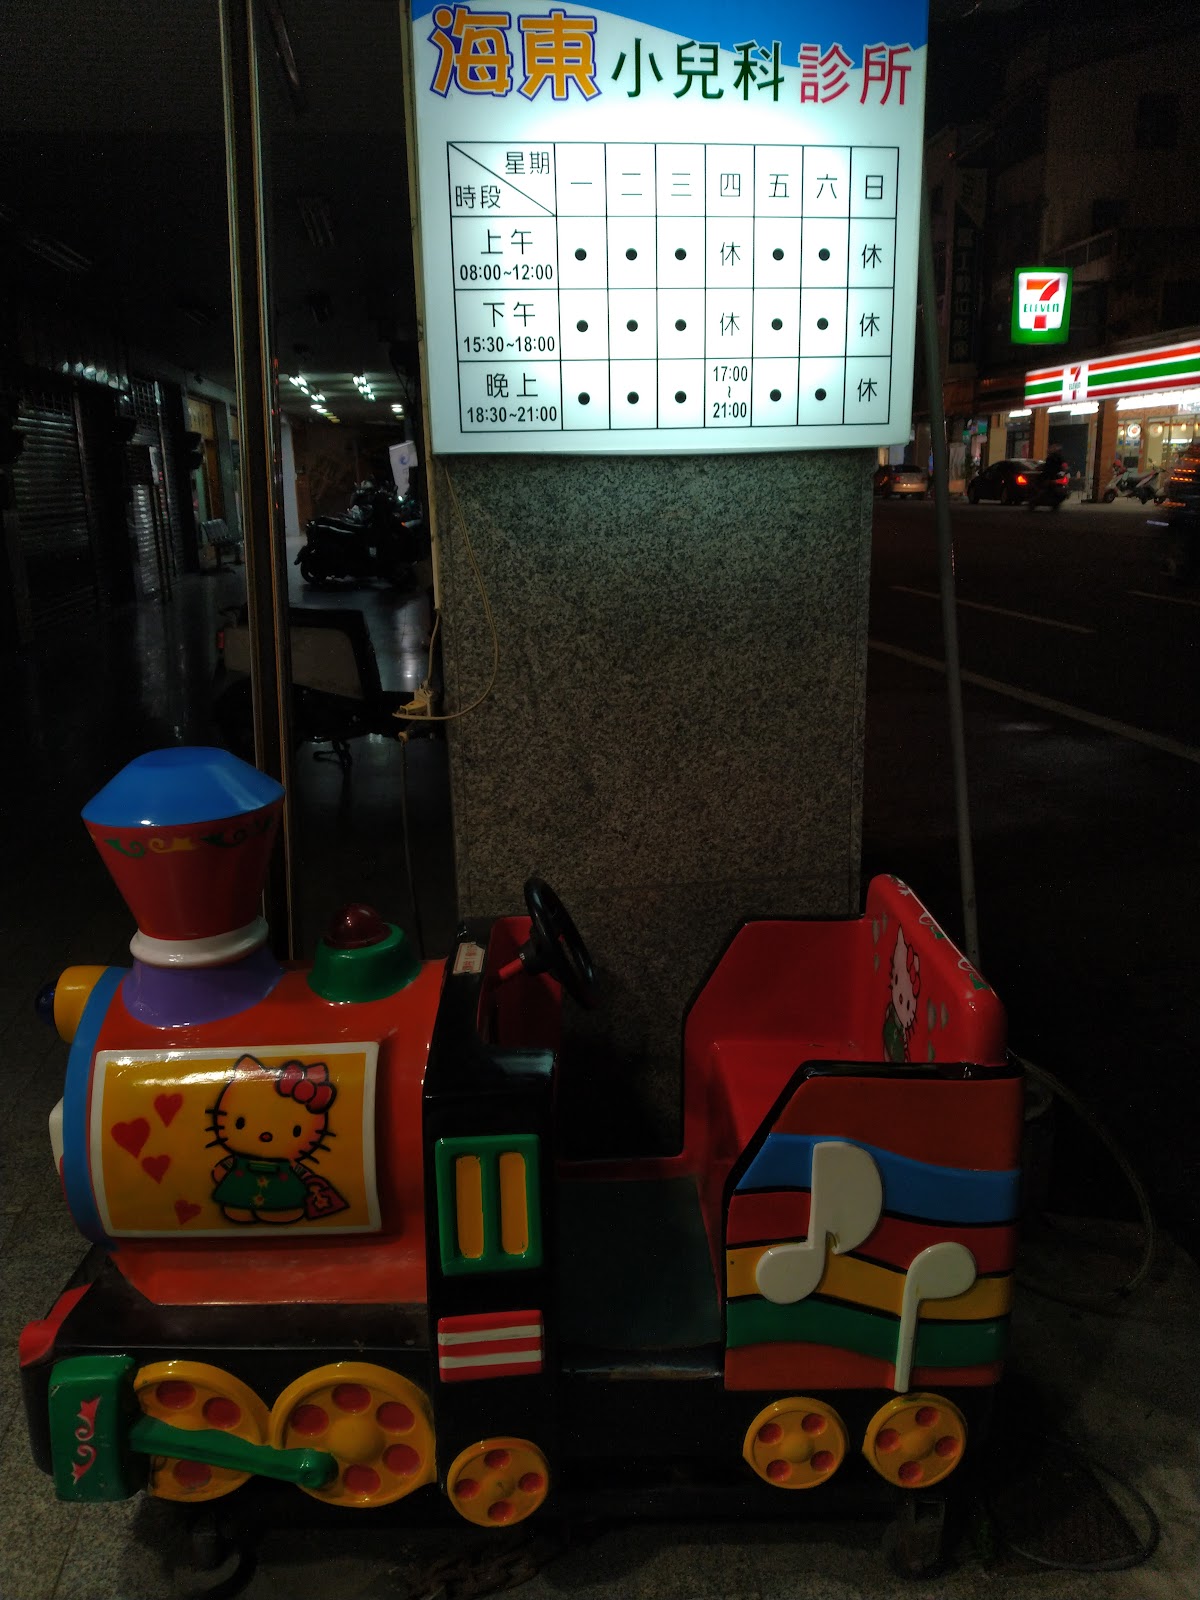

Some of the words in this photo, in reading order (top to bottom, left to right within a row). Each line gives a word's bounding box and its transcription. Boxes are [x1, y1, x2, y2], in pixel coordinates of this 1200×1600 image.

[427, 4, 912, 106] 海東小兒科診所
[504, 150, 550, 176] 星期
[455, 184, 501, 210] 時段
[620, 172, 643, 197] 二
[670, 172, 693, 198] 三
[719, 172, 741, 198] 四
[768, 173, 790, 199] 五
[816, 173, 838, 200] 六
[864, 174, 884, 200] 日
[480, 228, 534, 256] 上午
[719, 241, 741, 267] 休
[860, 243, 883, 270] 休
[459, 263, 553, 282] 08:00~12:00
[482, 301, 536, 328] 下午
[719, 311, 740, 337] 休
[858, 311, 881, 338] 休
[463, 335, 556, 354] 15:30~18:00
[485, 372, 539, 399] 晚上
[712, 365, 748, 382] 17:00
[857, 377, 878, 402] 休
[466, 405, 558, 424] 18:30~21:00
[712, 401, 748, 419] 21:00
